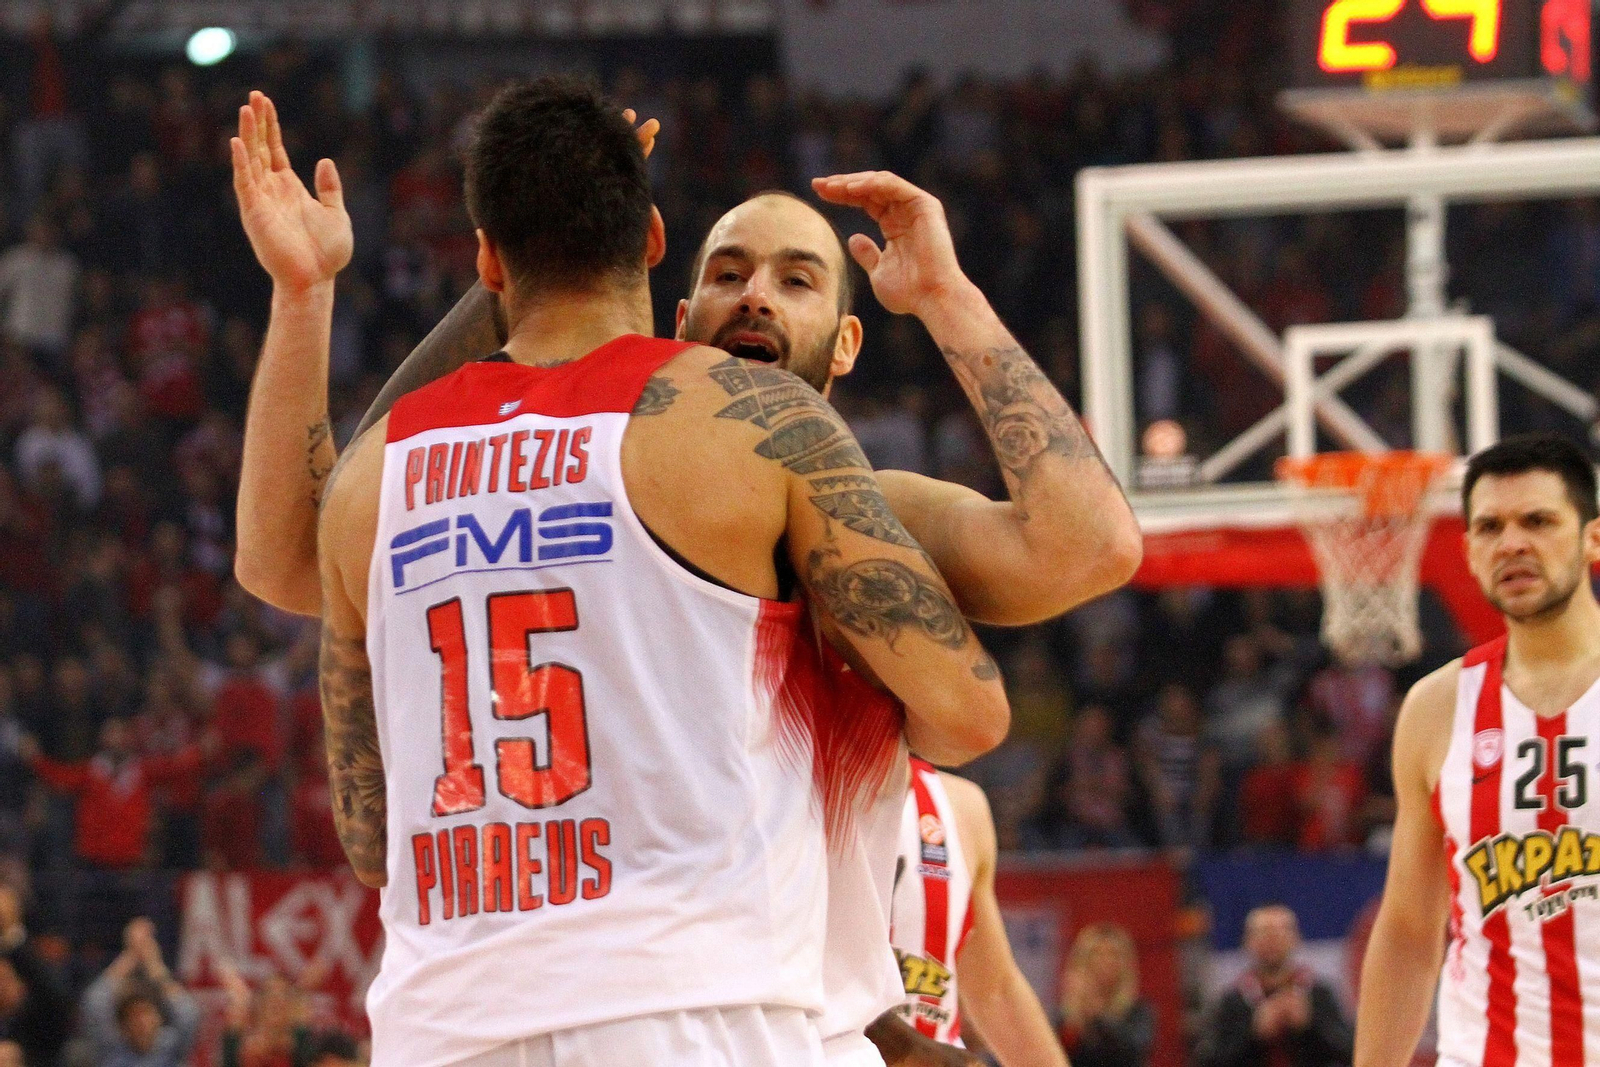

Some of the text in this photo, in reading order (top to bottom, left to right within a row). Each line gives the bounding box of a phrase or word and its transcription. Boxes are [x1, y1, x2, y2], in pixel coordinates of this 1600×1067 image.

[405, 426, 593, 511] PRINTEZIS
[390, 501, 614, 588] FMS
[426, 587, 592, 818] 15
[1514, 736, 1588, 809] 25
[412, 817, 612, 925] PIRAEUS
